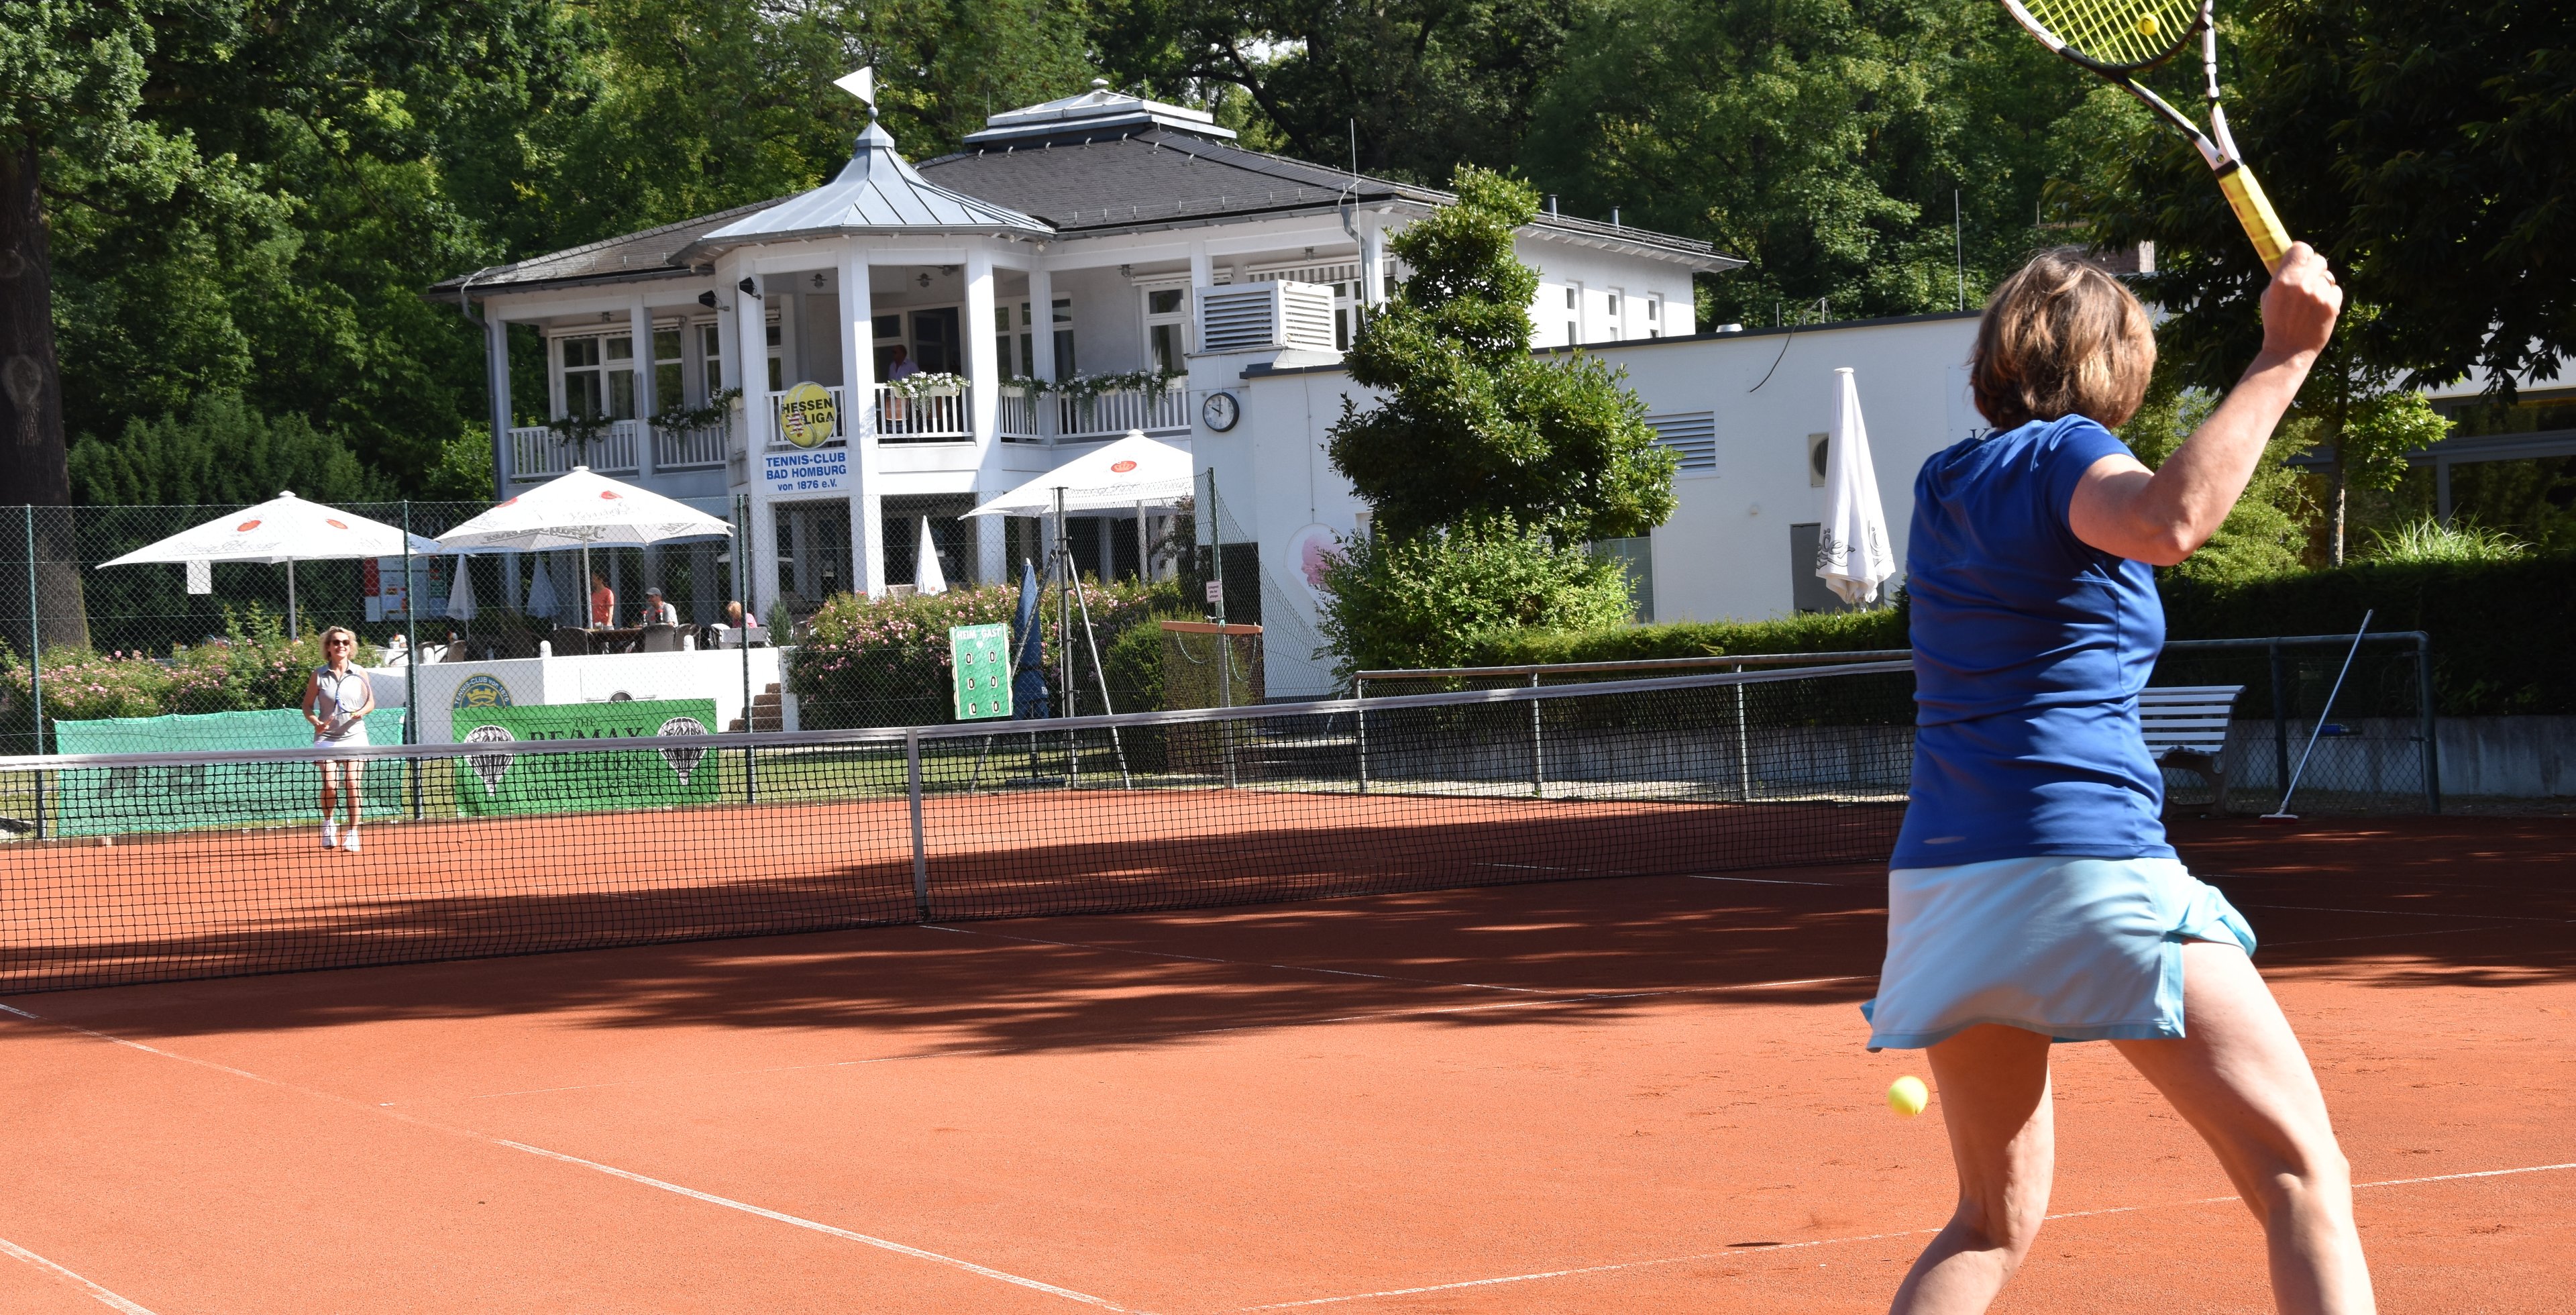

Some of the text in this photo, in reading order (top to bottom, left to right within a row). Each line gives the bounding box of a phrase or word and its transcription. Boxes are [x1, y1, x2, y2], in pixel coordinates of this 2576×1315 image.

[782, 398, 833, 414] HESSEN
[804, 411, 835, 425] LIGA
[765, 452, 846, 467] TENNIS-CLUB
[766, 464, 847, 480] BAD HOMBURG
[777, 478, 837, 491] von 1876 e.V.
[957, 628, 1001, 639] HEIM GAST
[966, 651, 995, 664] 0 0
[969, 676, 996, 688] 0 0
[454, 676, 510, 705] TENNIS-CLUB von 1876
[971, 701, 999, 713] 0 0
[574, 717, 597, 727] THE
